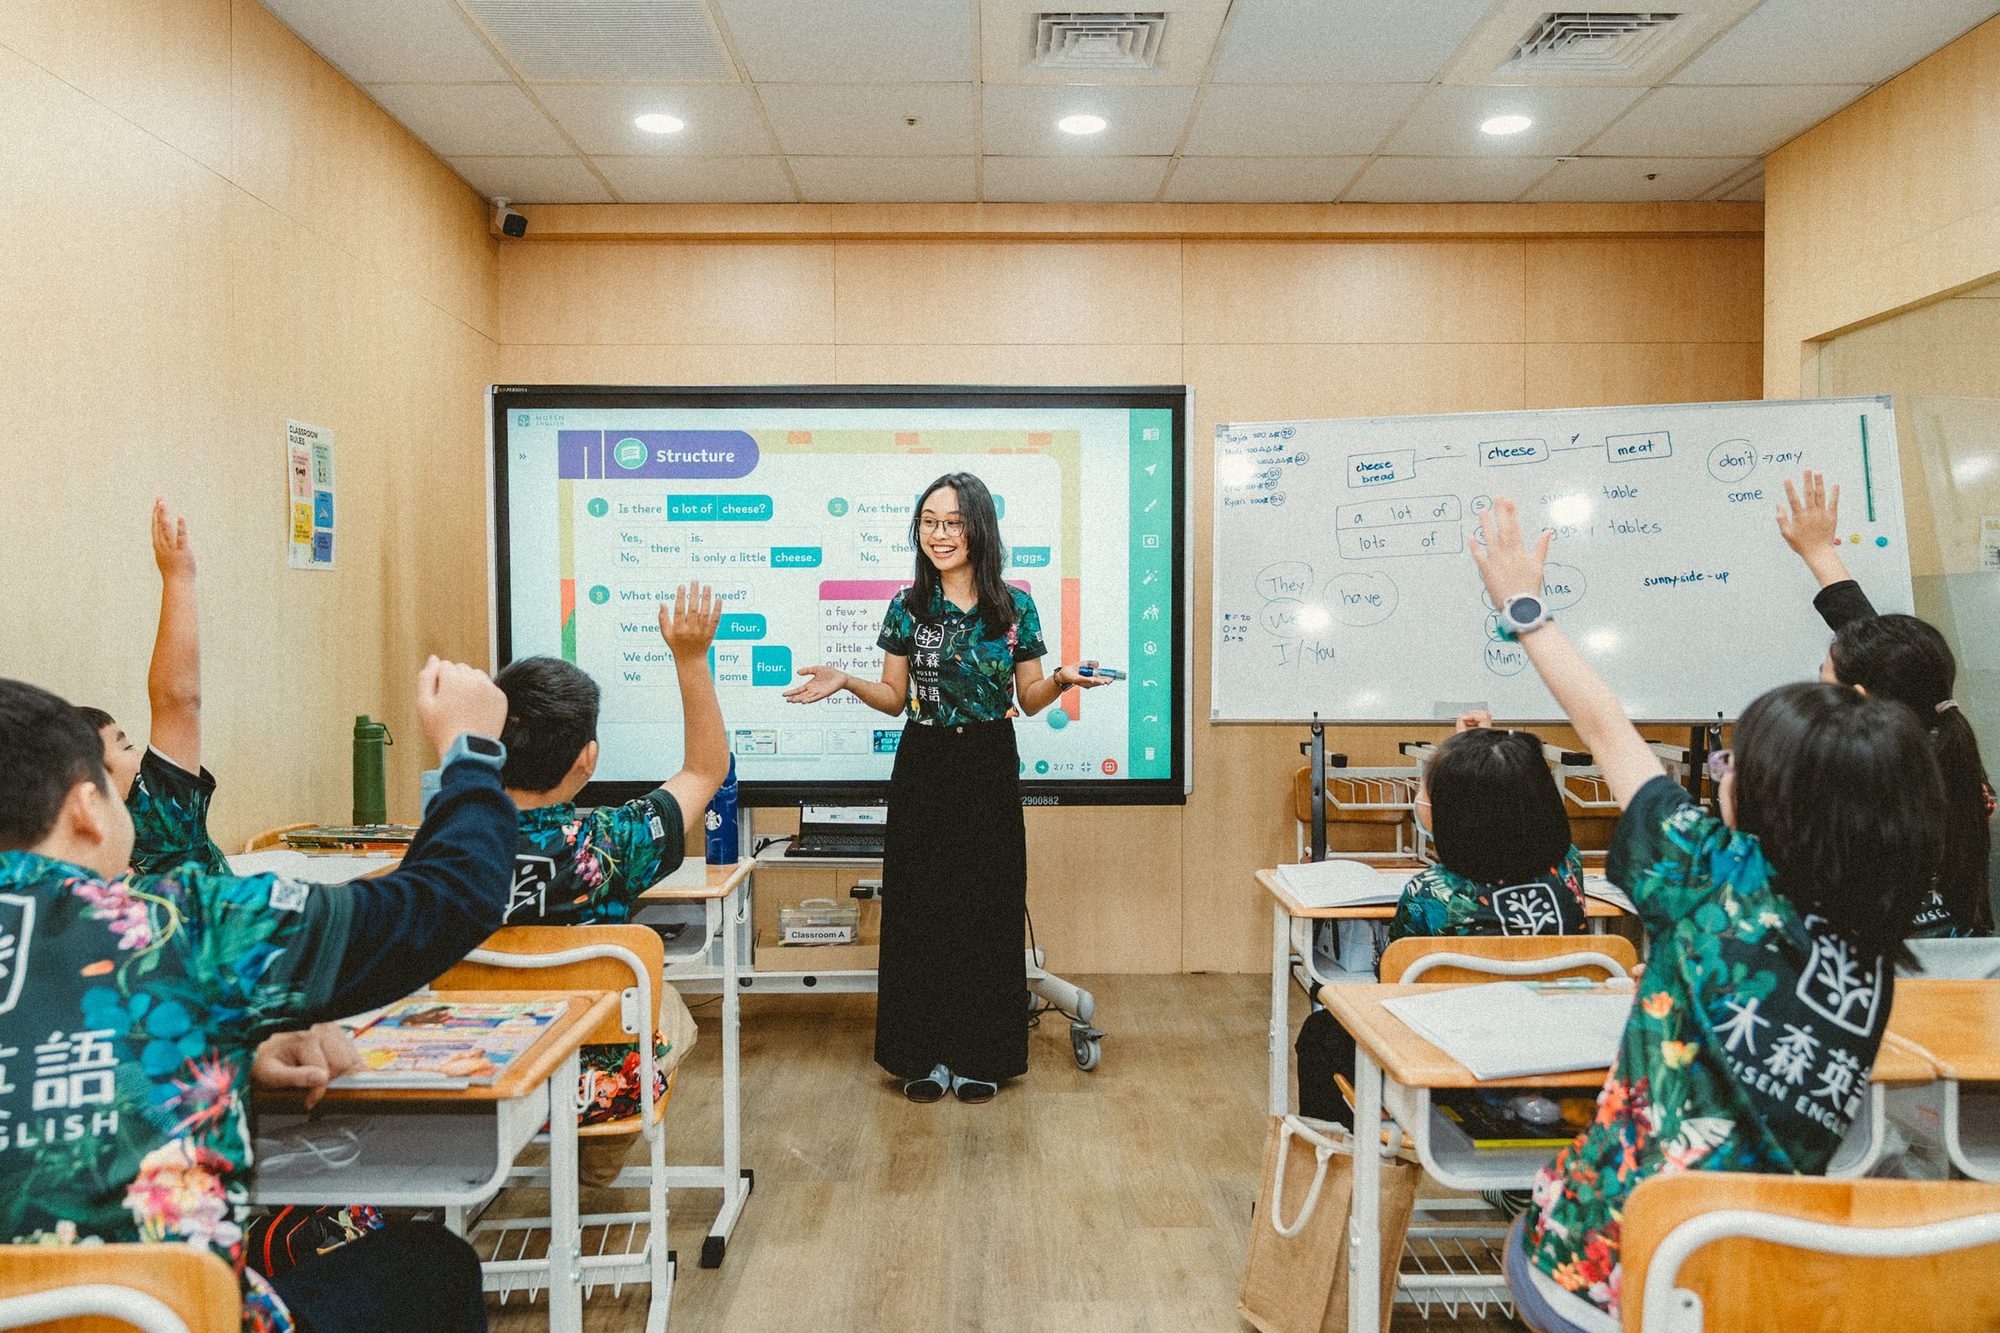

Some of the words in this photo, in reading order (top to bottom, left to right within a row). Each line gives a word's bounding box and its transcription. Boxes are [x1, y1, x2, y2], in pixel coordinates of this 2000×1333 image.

[289, 424, 318, 439] CLASSROOM
[289, 434, 305, 446] RULES
[1487, 445, 1537, 460] cheese
[1617, 440, 1656, 457] meat
[656, 448, 735, 464] Structure
[1776, 451, 1804, 465] any
[1355, 459, 1394, 473] cheese
[1361, 469, 1395, 484] bread
[1603, 485, 1639, 499] table
[1727, 487, 1764, 503] some
[618, 503, 629, 514] Is
[632, 503, 662, 514] there
[672, 505, 679, 514] a
[682, 503, 698, 514] lot
[700, 503, 714, 514] of
[722, 502, 766, 514] cheese?
[857, 503, 878, 514] Are
[880, 503, 911, 514] there
[1354, 512, 1364, 525] a
[1390, 501, 1414, 520] lot
[1432, 502, 1448, 518] of
[1608, 519, 1663, 535] tables
[620, 533, 643, 545] Yes,
[691, 533, 704, 543] is.
[860, 532, 883, 544] Yes,
[1359, 535, 1387, 553] lots
[1421, 530, 1439, 548] of
[650, 543, 681, 554] there
[620, 553, 641, 565] No,
[691, 552, 701, 563] is
[703, 552, 727, 566] only
[730, 555, 737, 563] a
[739, 552, 767, 563] little
[775, 552, 817, 564] cheese.
[859, 552, 880, 564] No,
[1015, 553, 1046, 564] eggs.
[1265, 575, 1306, 599] They
[1542, 573, 1572, 596] has
[619, 590, 652, 601] What
[655, 590, 675, 601] else
[714, 590, 748, 601] need?
[1340, 589, 1383, 608] have
[836, 606, 856, 617] few
[620, 623, 639, 633] We
[730, 622, 761, 633] flour.
[825, 621, 849, 634] only
[851, 621, 868, 631] for
[826, 645, 832, 653] a
[835, 643, 862, 653] little
[623, 652, 641, 662] We
[644, 652, 674, 662] don't
[719, 654, 739, 665] any
[913, 649, 941, 669] 木森
[1488, 649, 1522, 665] Mimi
[756, 662, 787, 673] flour.
[826, 658, 849, 670] only
[852, 658, 869, 668] for
[623, 672, 641, 682] We
[719, 672, 748, 682] some
[918, 685, 941, 702] 英語
[791, 930, 837, 940] Classroom
[838, 930, 846, 940] A
